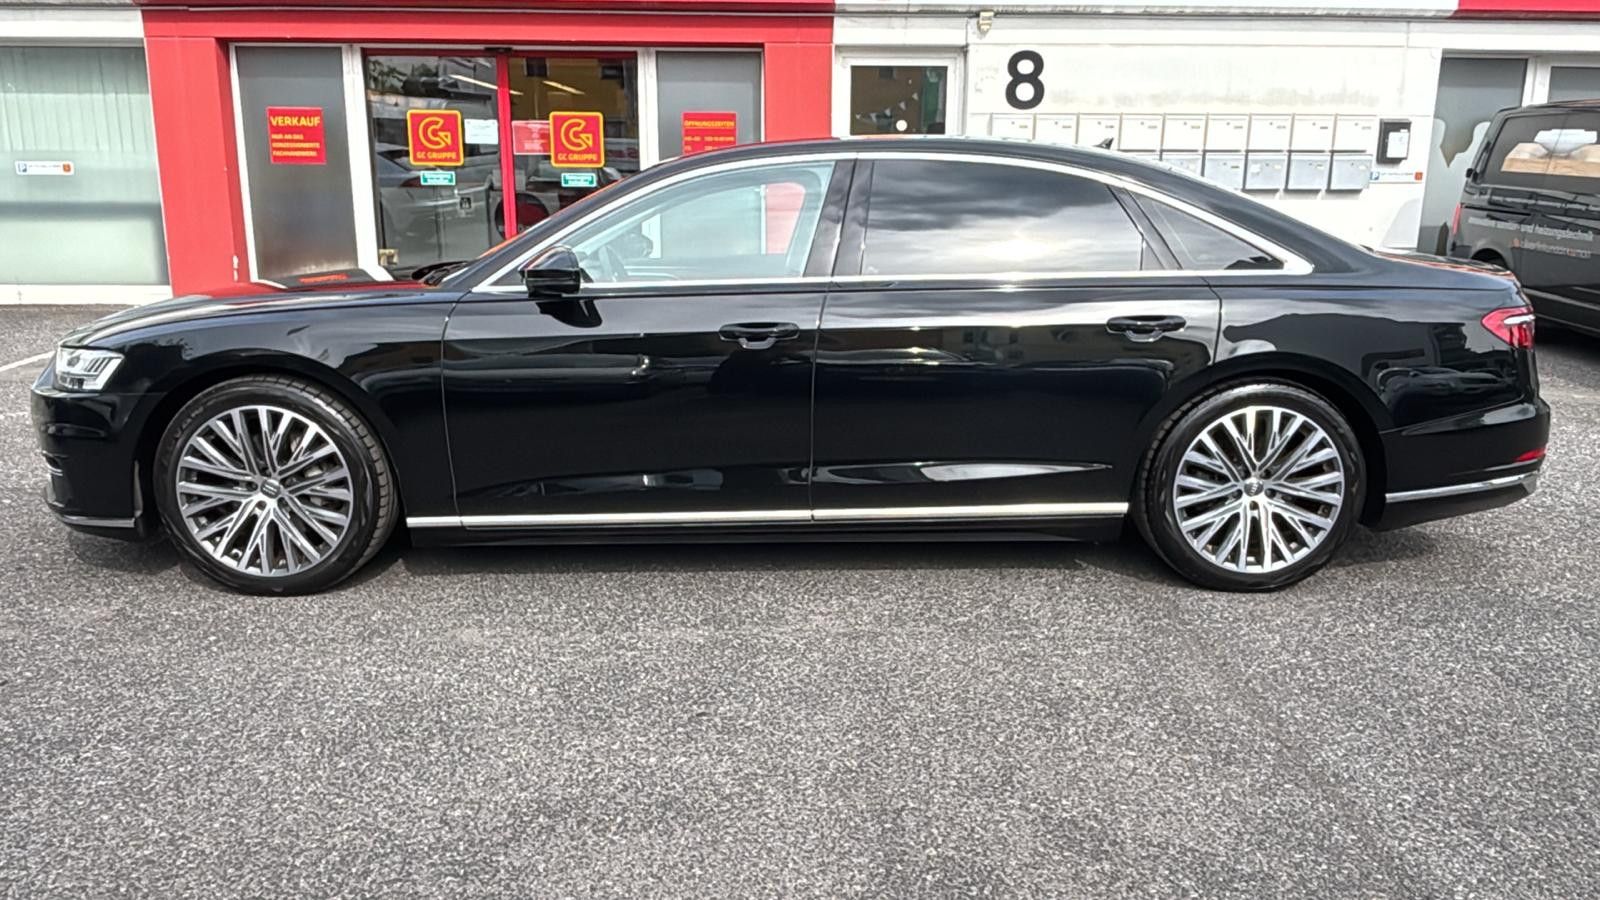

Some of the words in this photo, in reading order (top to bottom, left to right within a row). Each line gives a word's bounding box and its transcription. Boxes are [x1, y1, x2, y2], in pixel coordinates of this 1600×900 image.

[1005, 50, 1045, 110] 8
[270, 115, 321, 127] VERKAUF
[427, 151, 457, 160] GRUPPE
[568, 153, 598, 161] GRUPPE
